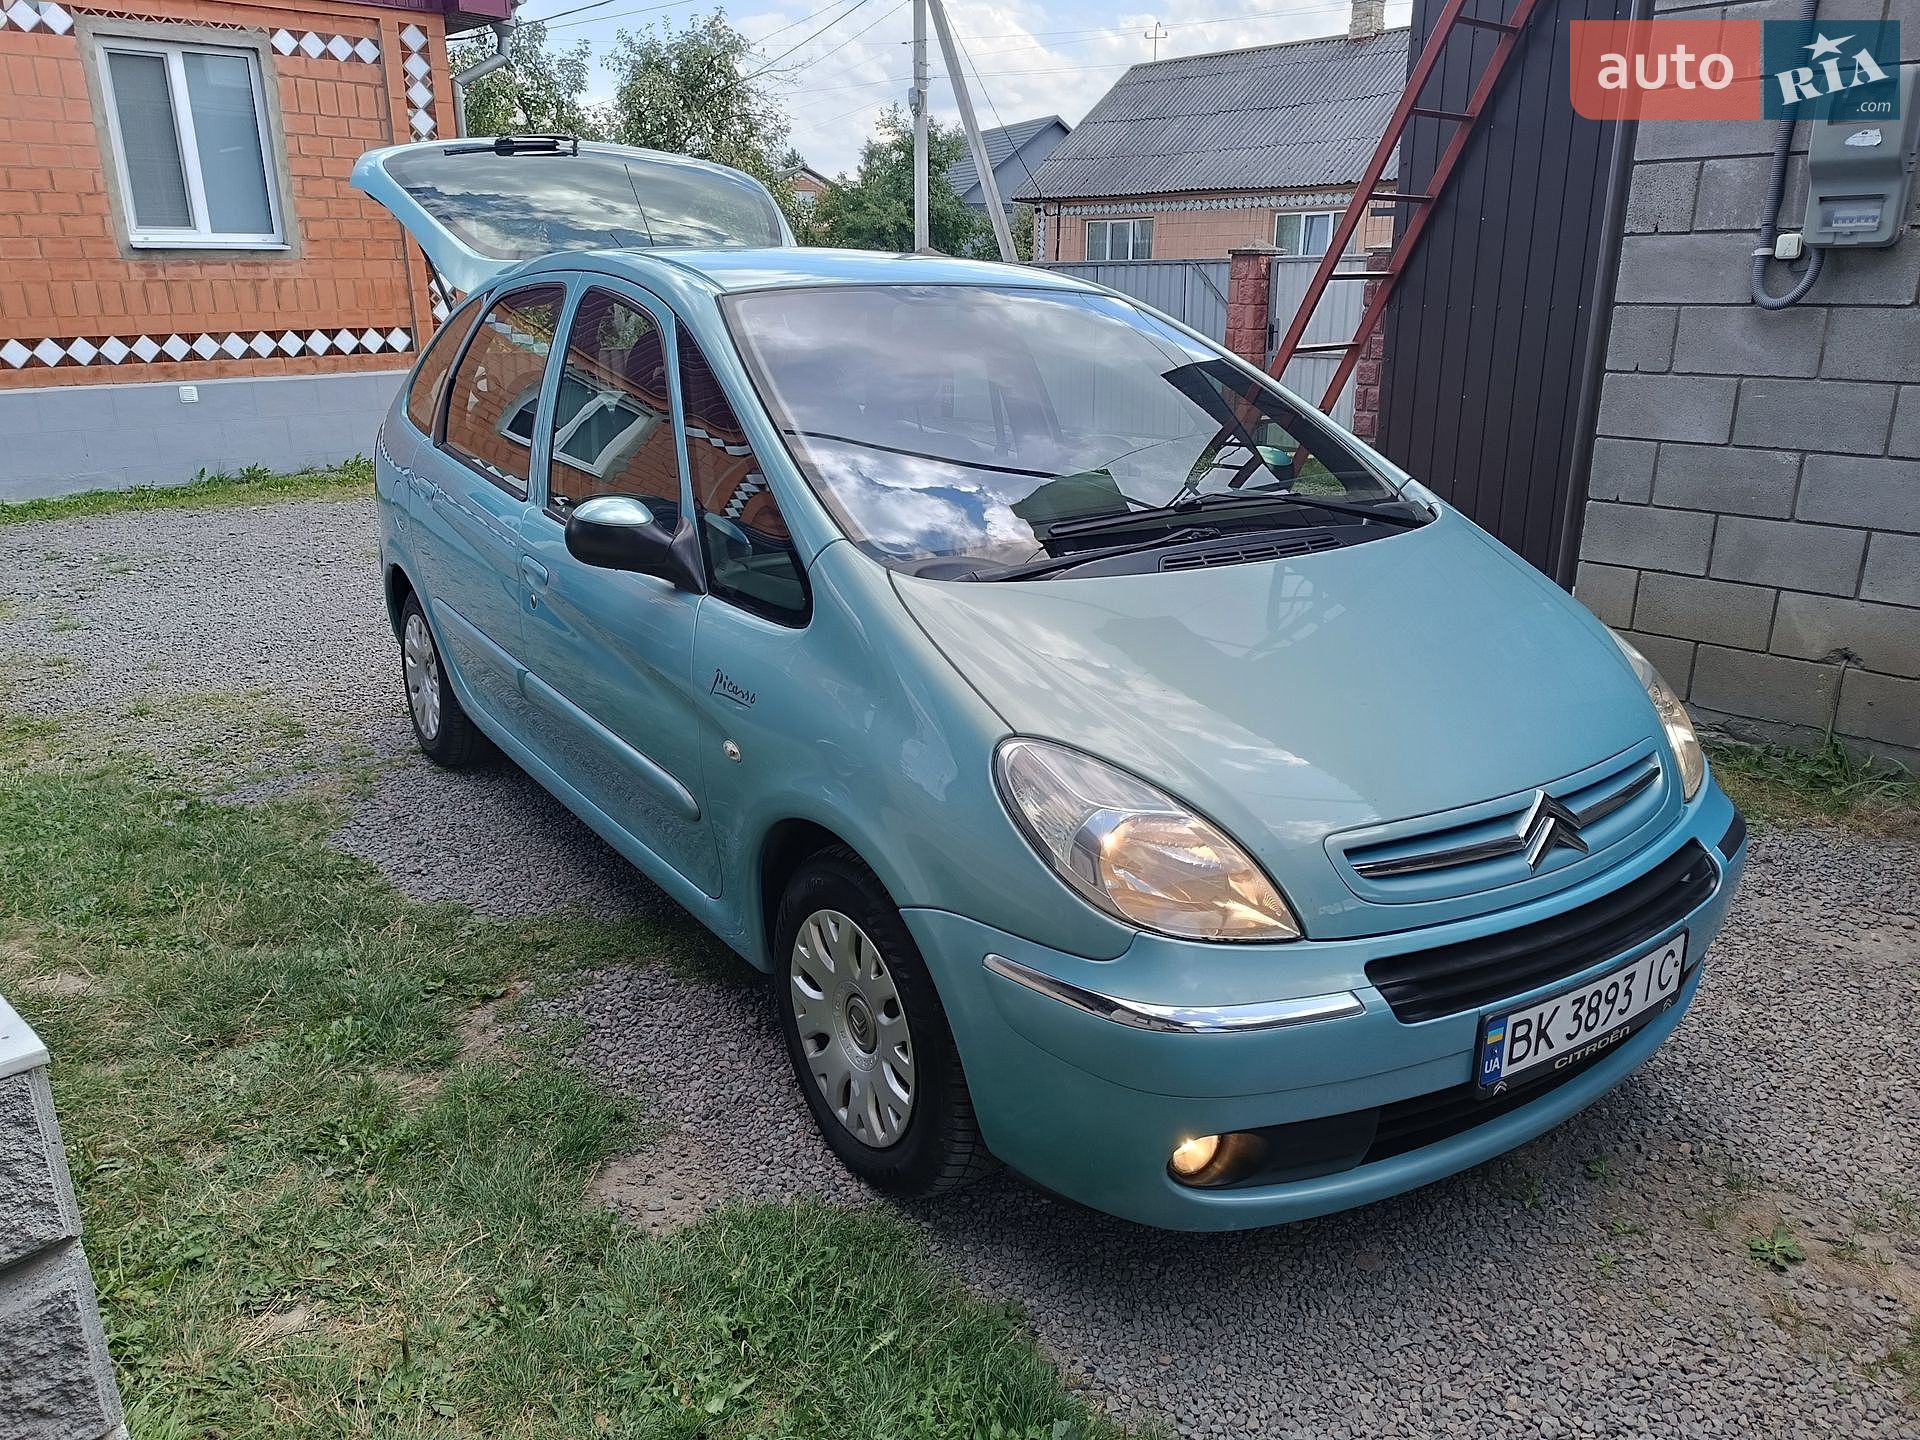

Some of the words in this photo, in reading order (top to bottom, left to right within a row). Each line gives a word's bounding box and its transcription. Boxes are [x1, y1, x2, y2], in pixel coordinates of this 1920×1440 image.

[710, 668, 756, 706] Picasso
[1508, 1005, 1560, 1066] BK
[1565, 971, 1636, 1041] 3893
[1645, 949, 1675, 1002] IC
[1484, 1057, 1500, 1074] UA
